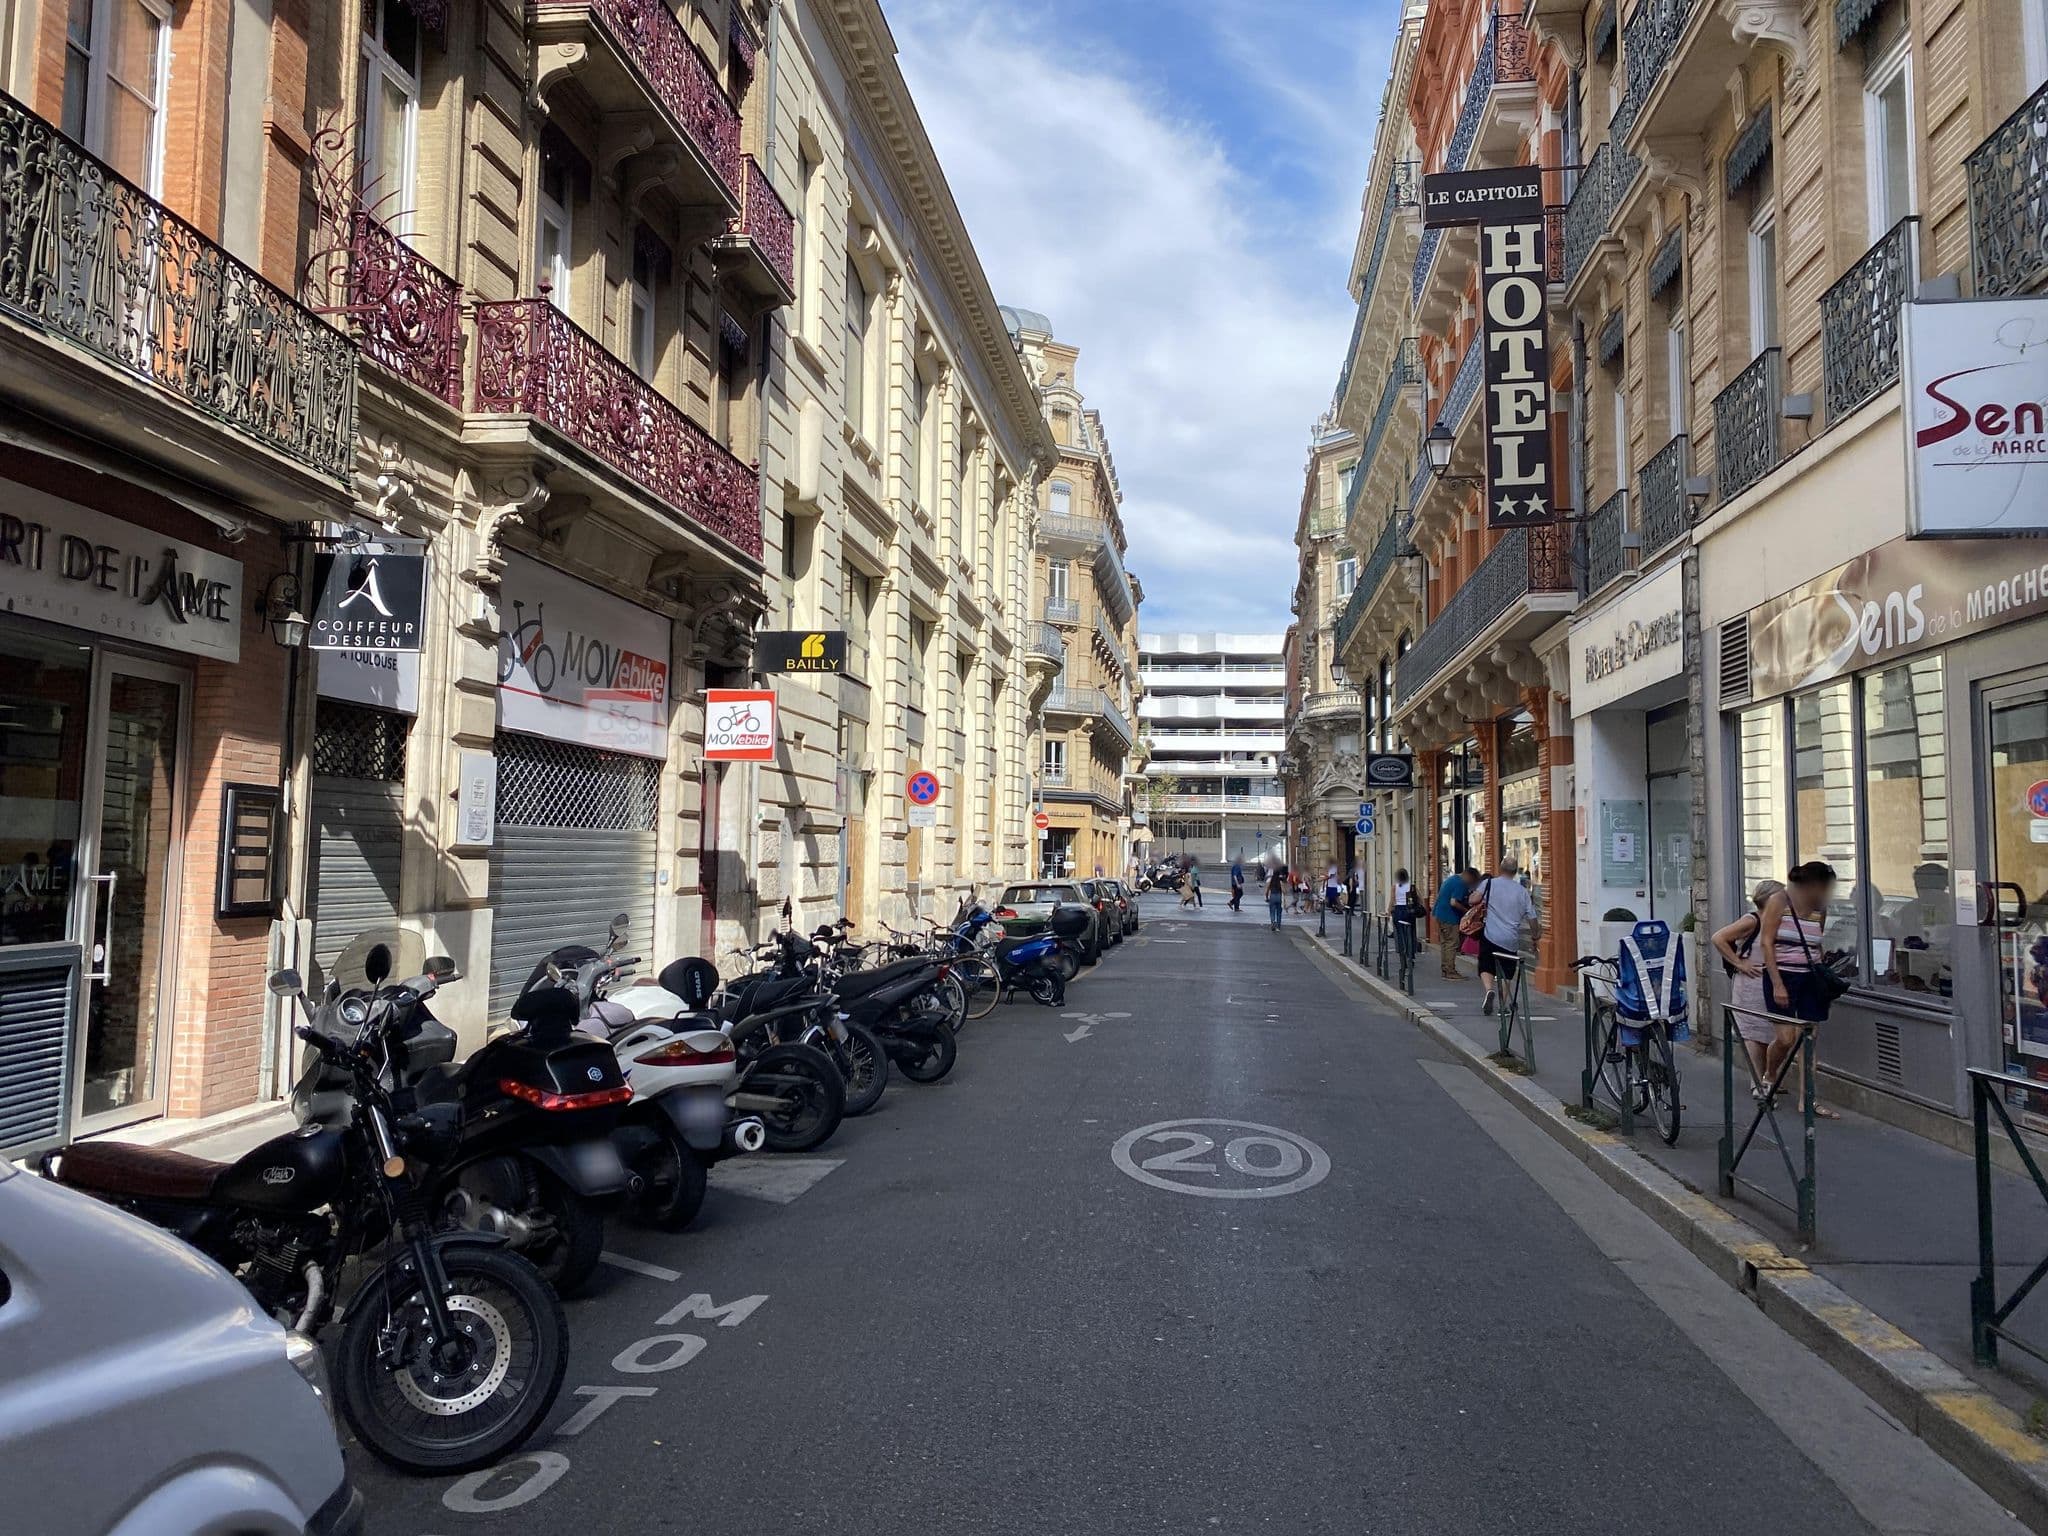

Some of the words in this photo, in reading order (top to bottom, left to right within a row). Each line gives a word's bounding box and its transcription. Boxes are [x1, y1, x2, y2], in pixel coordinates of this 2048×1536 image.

[1428, 190, 1450, 205] LE
[1455, 184, 1539, 203] CAPITOLE
[1483, 223, 1547, 487] HOTEL
[1992, 439, 2047, 454] MARC
[61, 534, 120, 592] DE
[317, 619, 414, 634] COIFFEUR
[328, 634, 401, 648] DESIGN
[1795, 583, 1926, 689] Sens
[786, 658, 839, 671] BAILLY
[707, 733, 770, 747] MOVebike
[1141, 1131, 1304, 1178] 20
